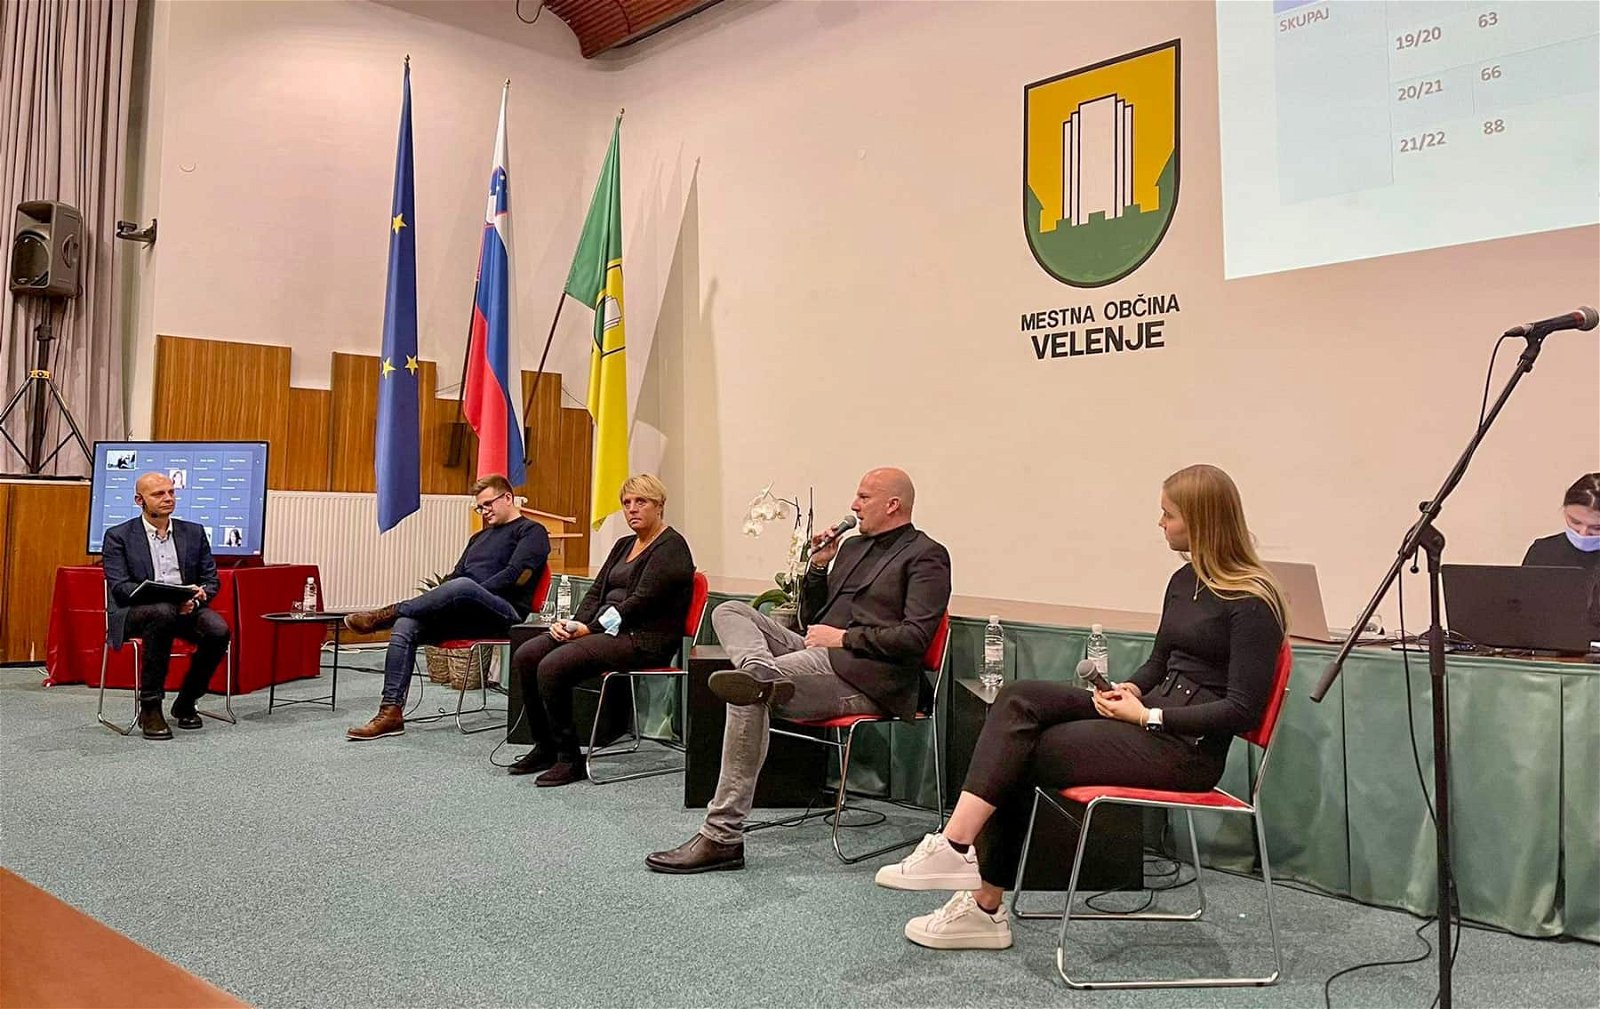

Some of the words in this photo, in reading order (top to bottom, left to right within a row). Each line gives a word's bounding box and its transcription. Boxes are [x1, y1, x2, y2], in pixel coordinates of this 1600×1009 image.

[1279, 7, 1330, 32] SKUPAJ
[1396, 26, 1442, 50] 19/20
[1478, 11, 1498, 28] 63
[1398, 79, 1443, 101] 20/21
[1480, 65, 1502, 81] 66
[1400, 131, 1446, 152] 21/22
[1483, 119, 1505, 135] 88
[1021, 305, 1095, 331] MESTNA
[1104, 294, 1180, 321] OBČINA
[1031, 320, 1165, 360] VELENJE
